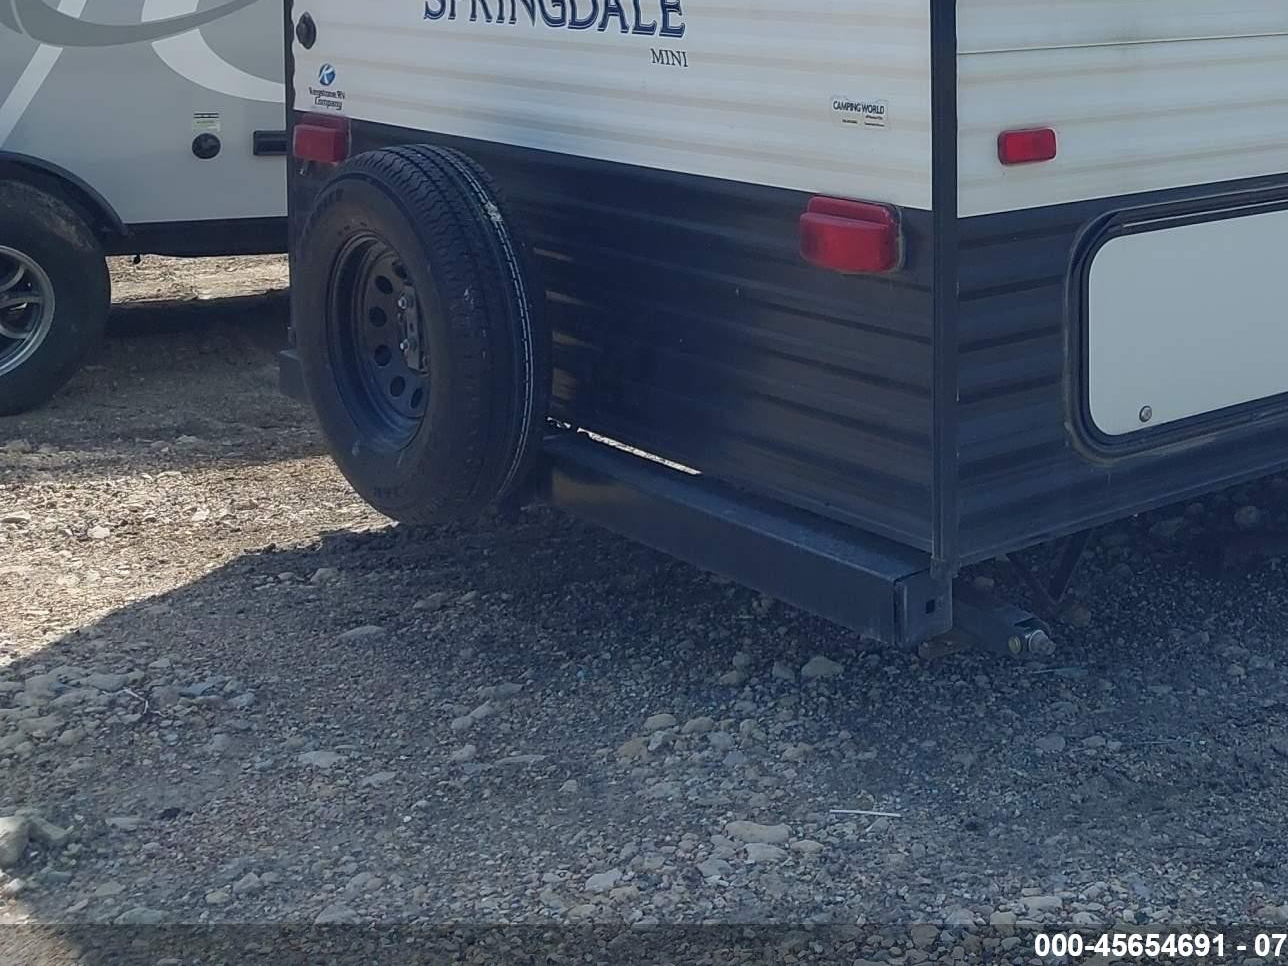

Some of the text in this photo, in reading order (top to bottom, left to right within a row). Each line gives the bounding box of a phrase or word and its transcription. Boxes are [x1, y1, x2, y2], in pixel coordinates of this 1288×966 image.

[651, 48, 689, 68] MINI
[833, 100, 885, 115] CAMPING WORLD
